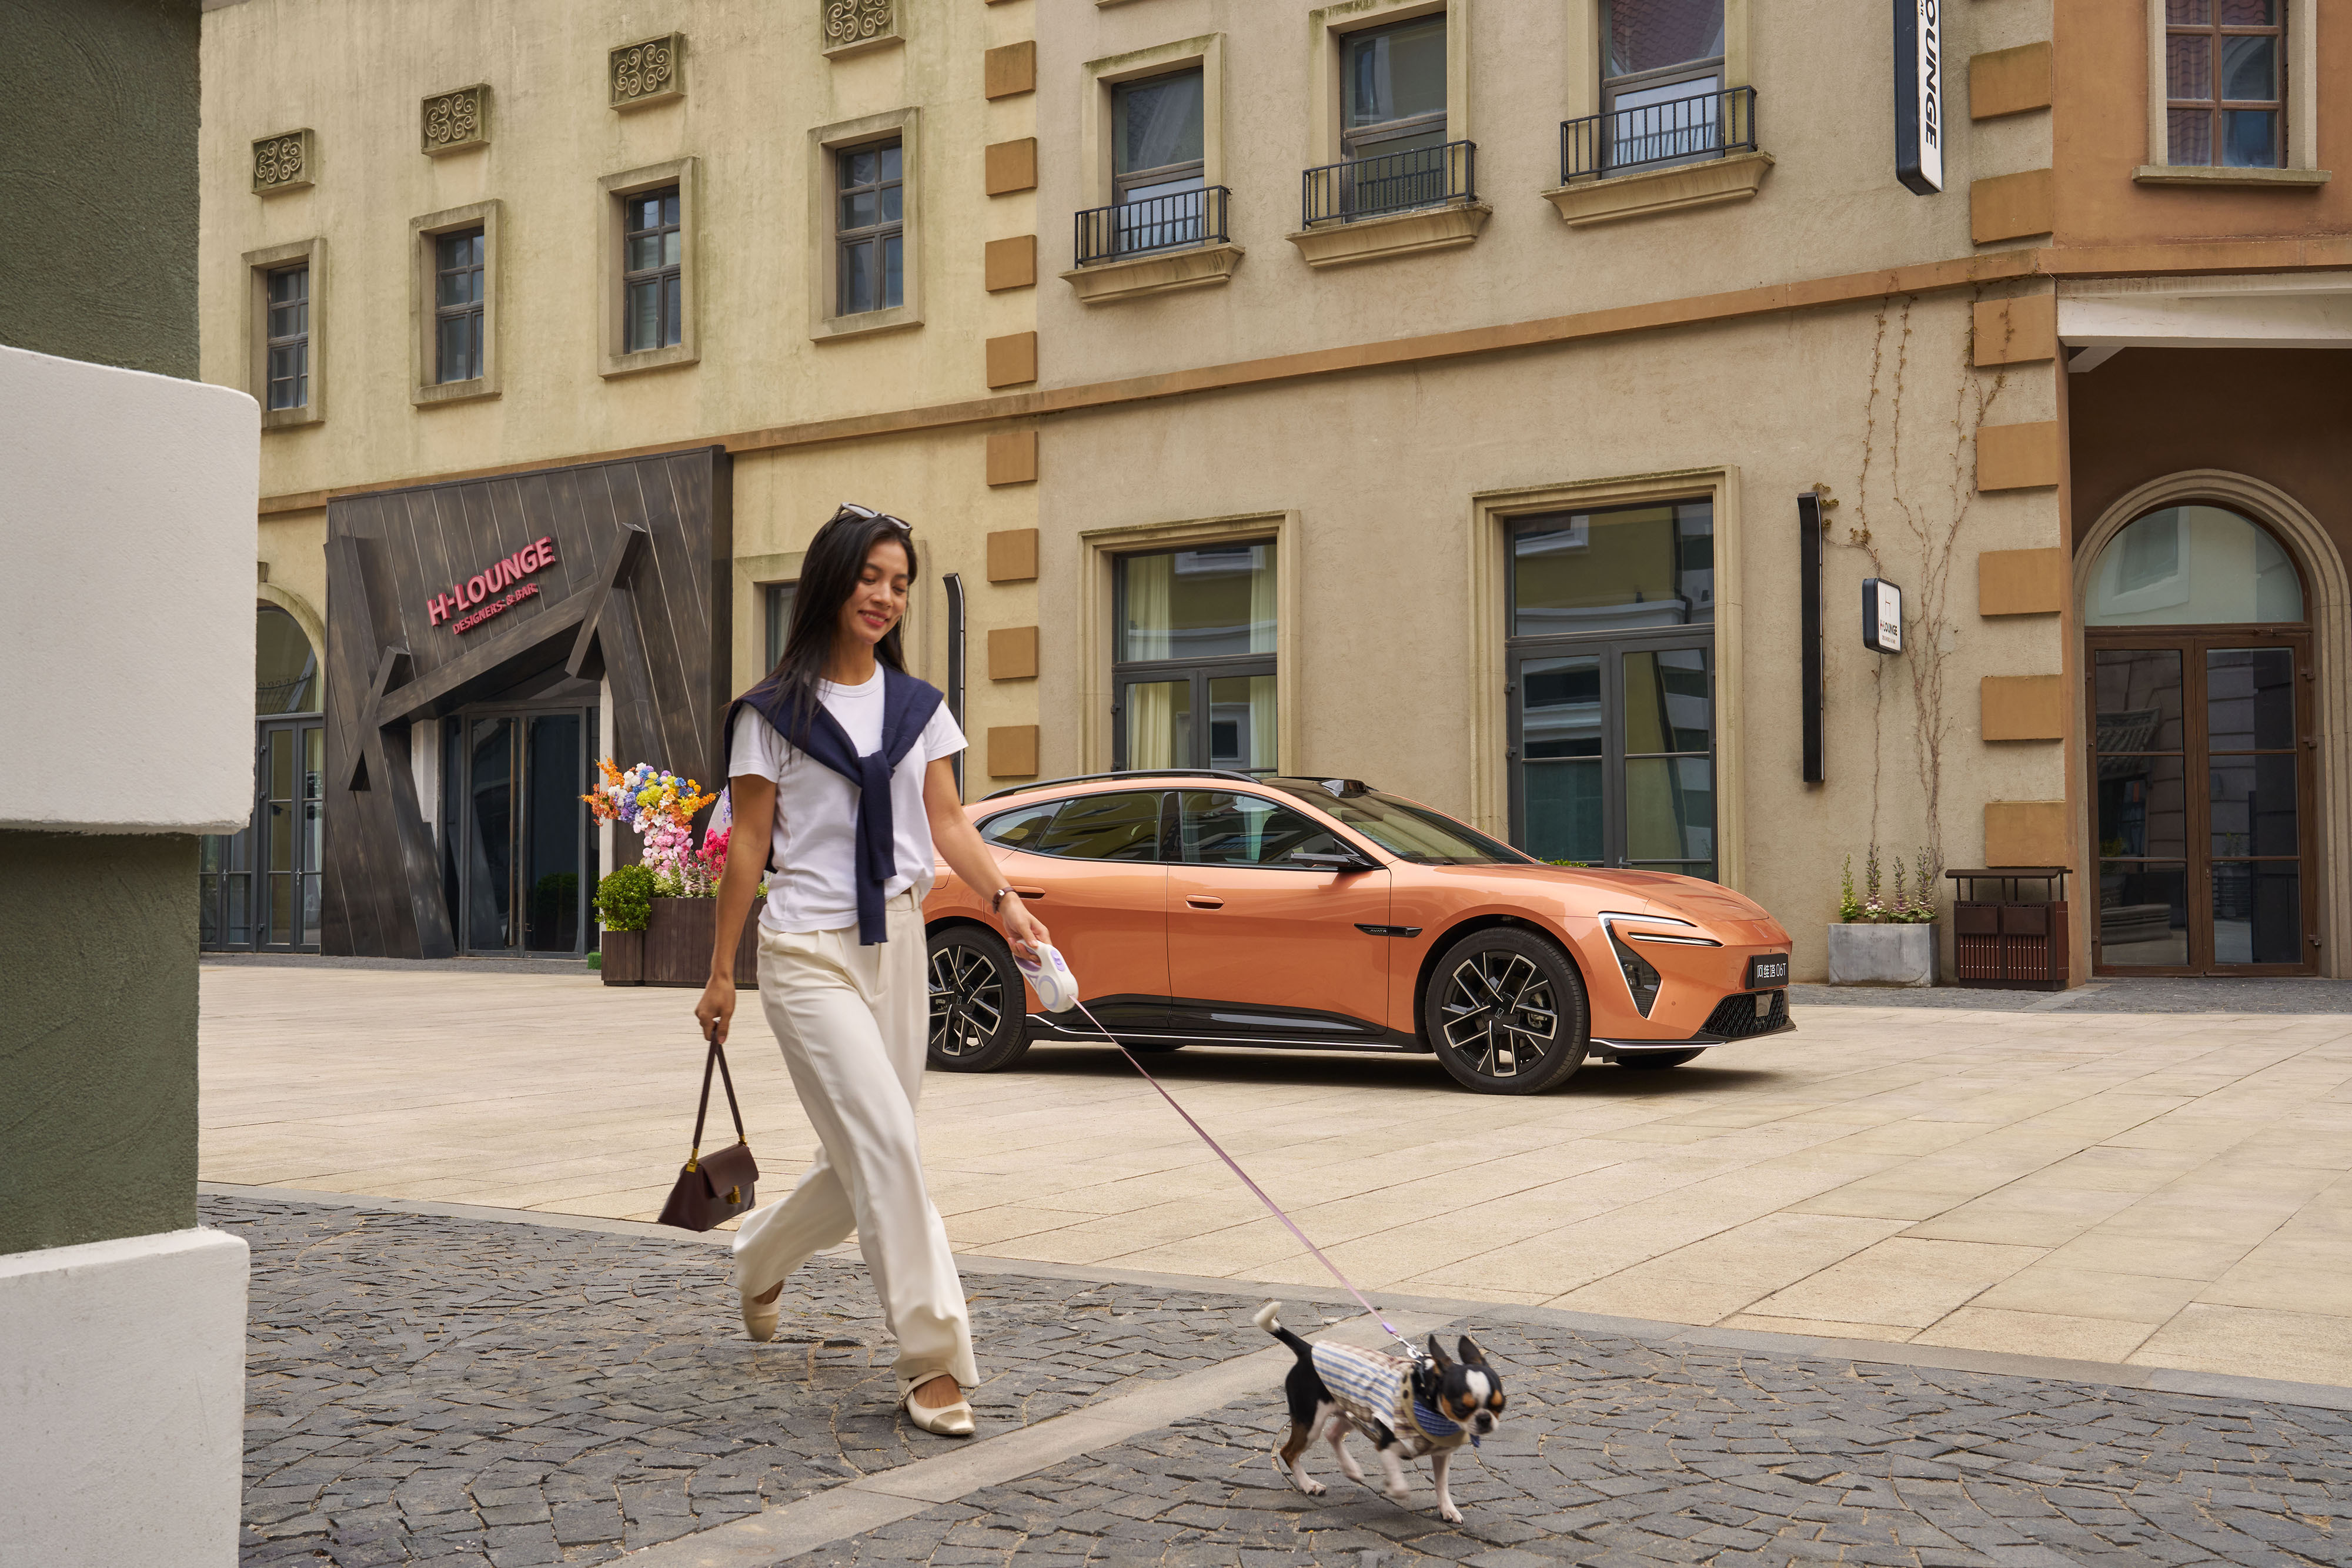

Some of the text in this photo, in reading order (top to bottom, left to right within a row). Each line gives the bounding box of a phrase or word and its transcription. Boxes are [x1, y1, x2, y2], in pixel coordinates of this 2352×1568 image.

[427, 536, 556, 626] H-LOUNGE
[452, 583, 539, 635] DESIGNERS & BAR
